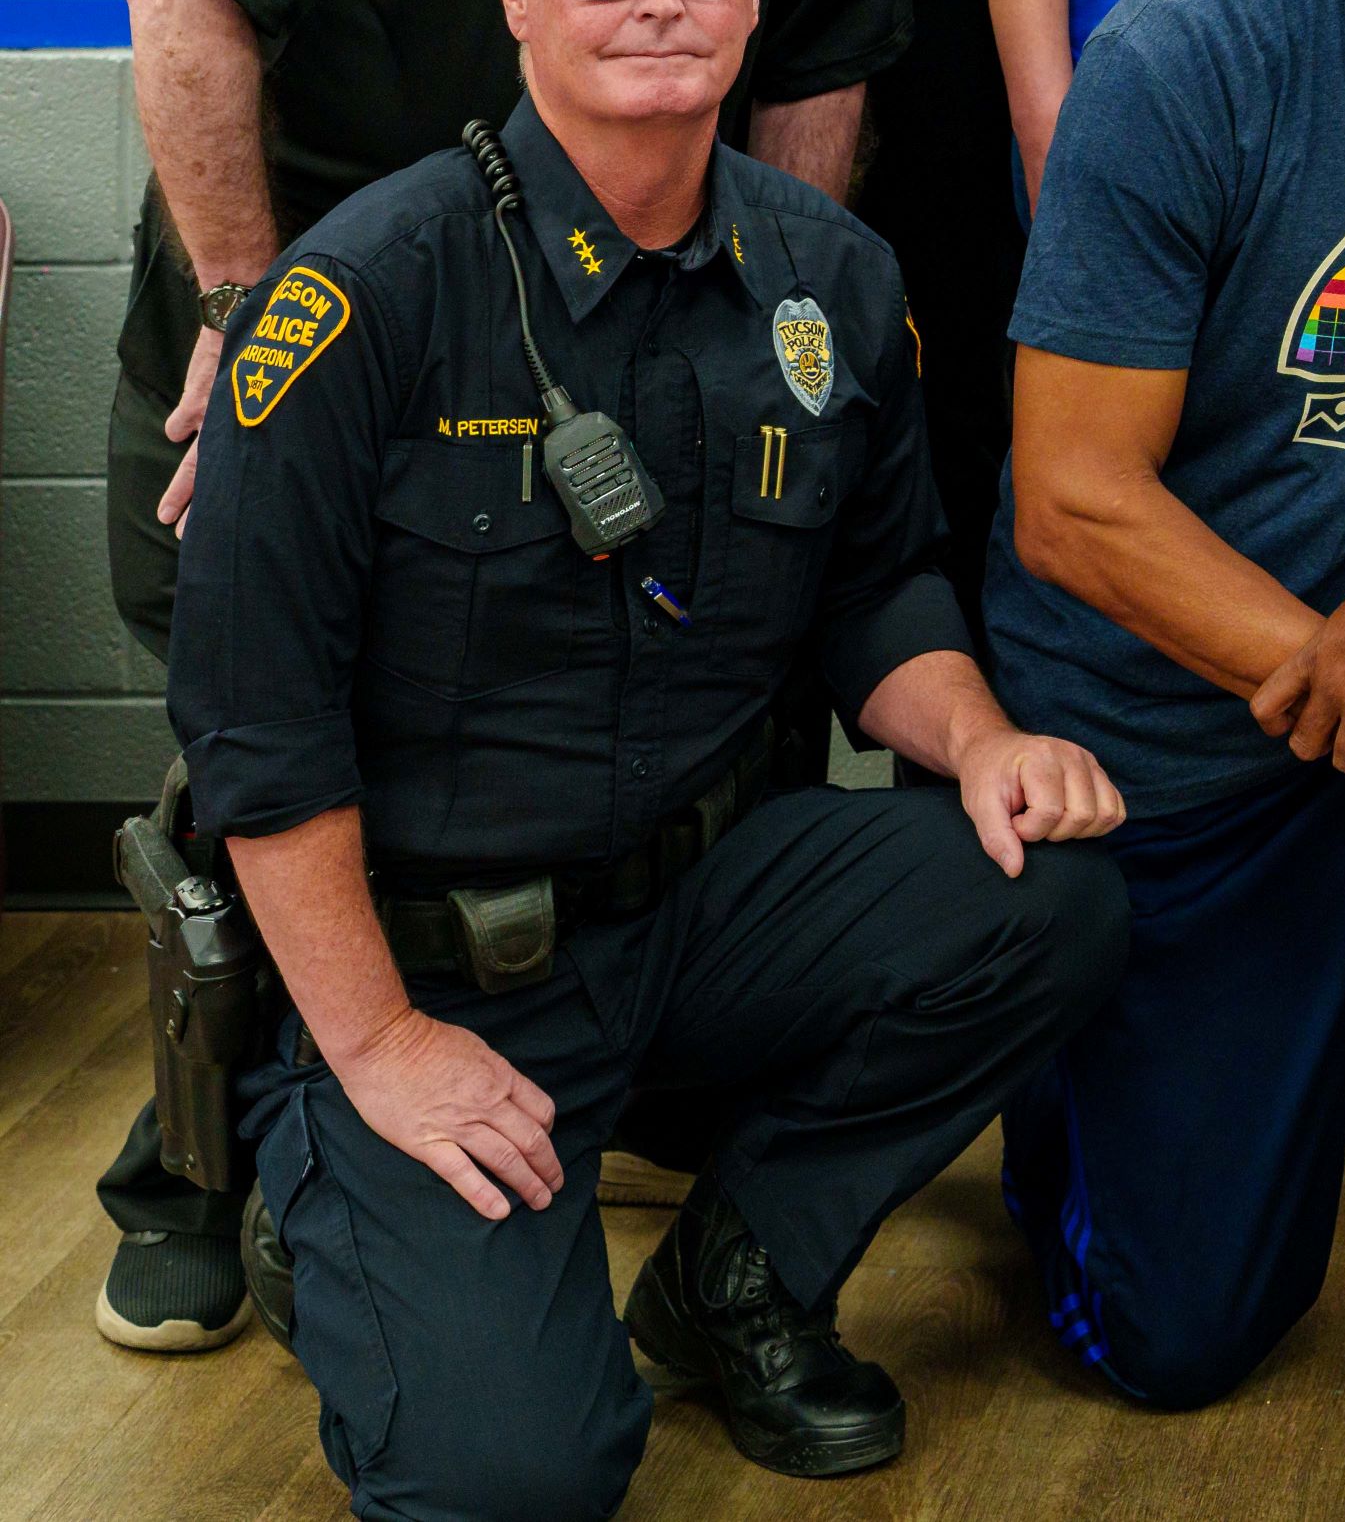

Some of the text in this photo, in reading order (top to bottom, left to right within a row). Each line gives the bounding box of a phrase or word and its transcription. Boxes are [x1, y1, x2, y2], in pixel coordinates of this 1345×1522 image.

[256, 314, 319, 348] OLICE
[778, 321, 825, 339] TUCSON
[787, 336, 824, 352] POLICE
[240, 344, 295, 369] ARIZONA
[438, 418, 538, 437] M. PETERSEN
[600, 500, 640, 525] MOTOROLA
